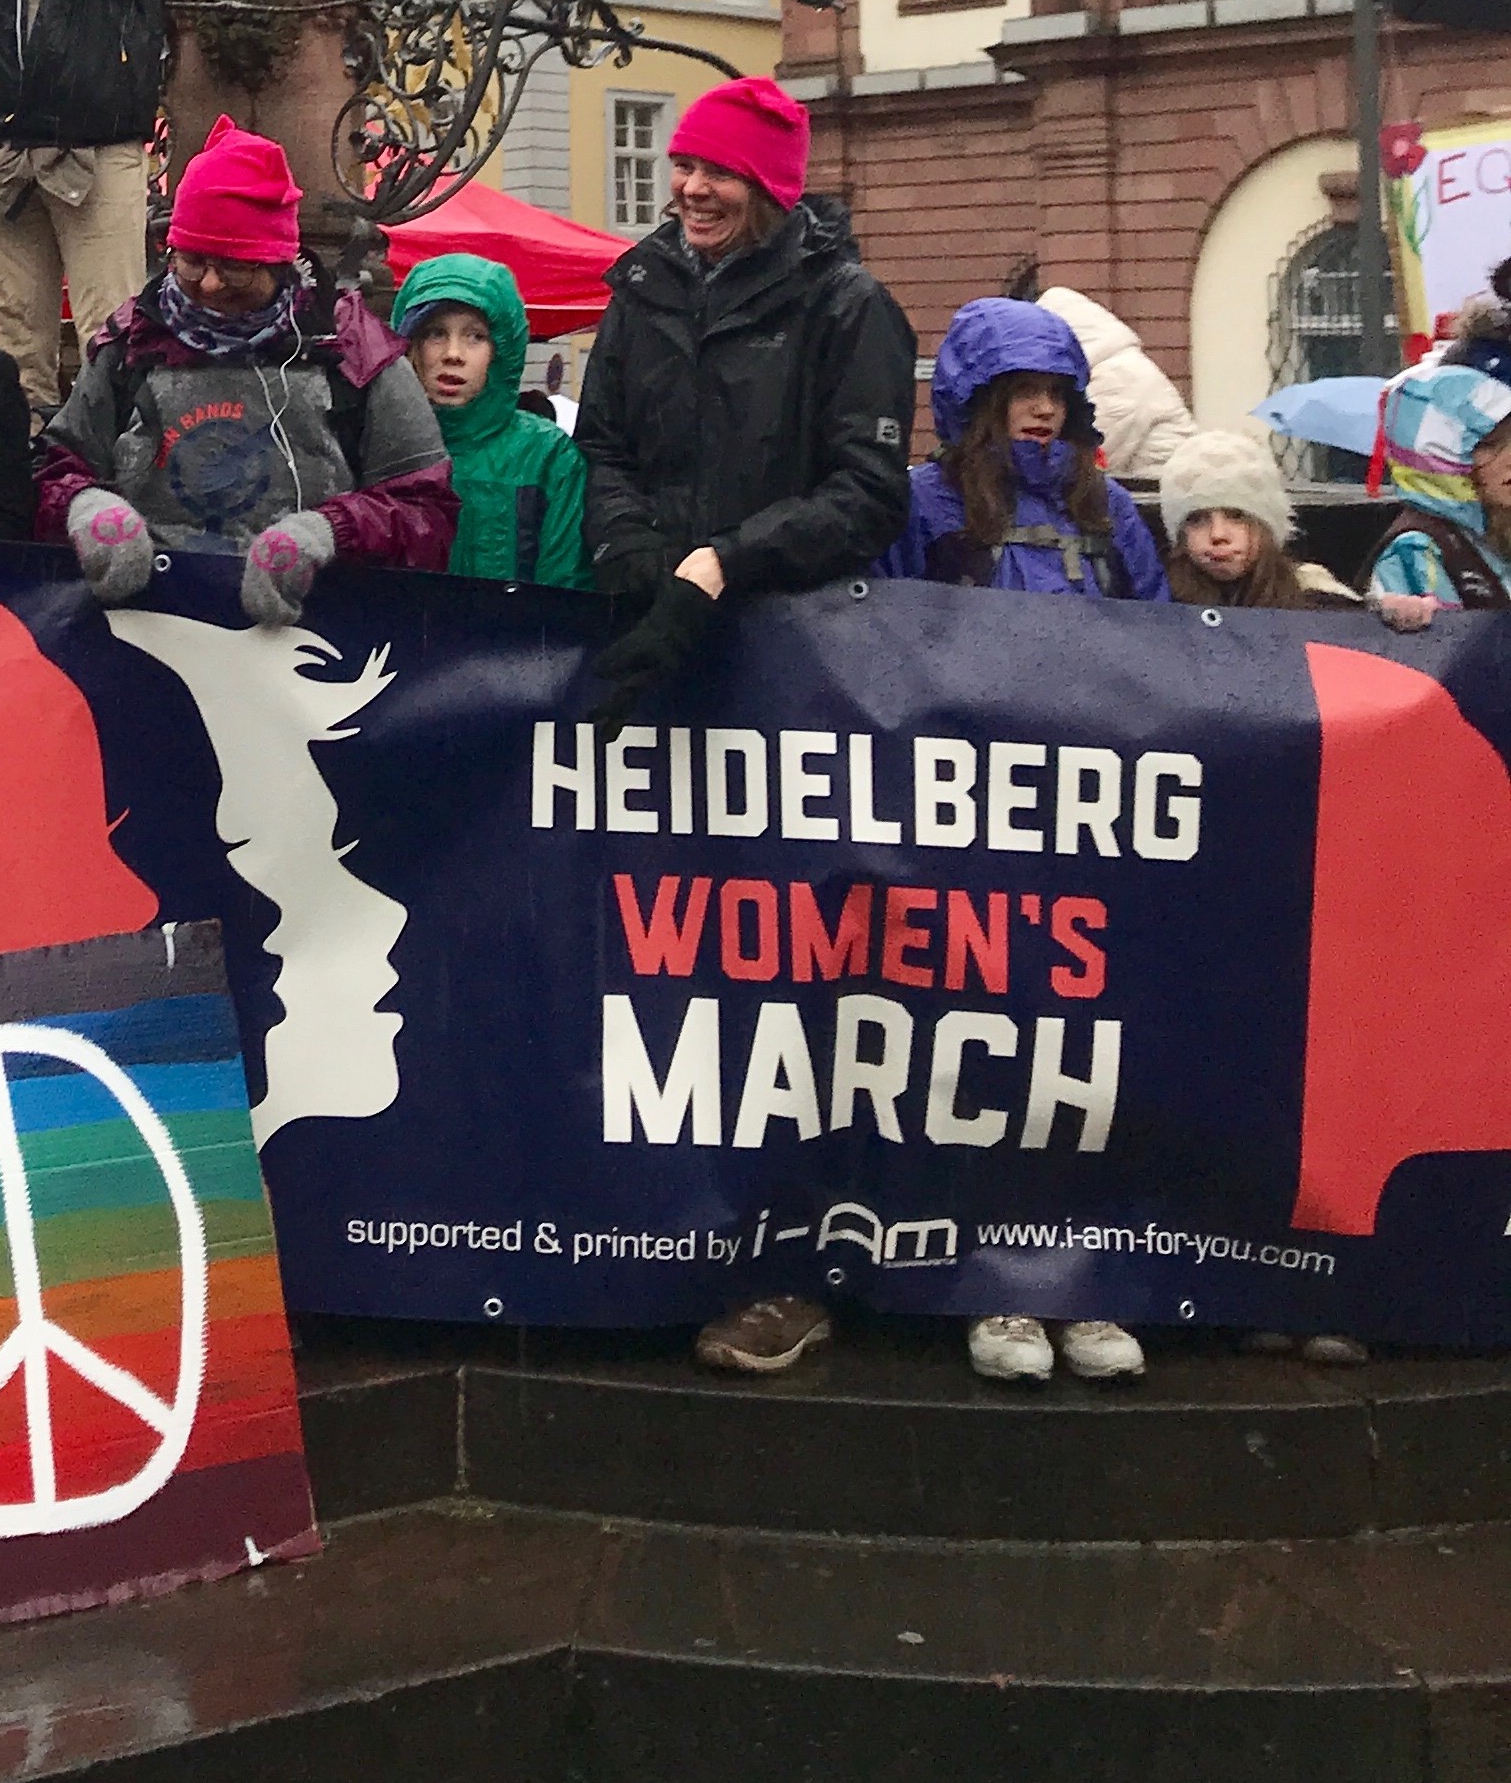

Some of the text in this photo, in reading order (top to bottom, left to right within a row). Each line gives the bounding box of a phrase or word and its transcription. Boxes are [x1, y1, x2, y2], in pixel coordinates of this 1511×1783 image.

[531, 720, 1203, 861] HEIDELBERG
[613, 873, 1108, 999] WOMEN'S
[602, 994, 1122, 1152] MARCH
[346, 1218, 522, 1254] supported
[533, 1222, 563, 1255] &
[573, 1226, 696, 1264] printed
[707, 1232, 741, 1266] by
[976, 1218, 1336, 1275] www.i-am-for-you.com
